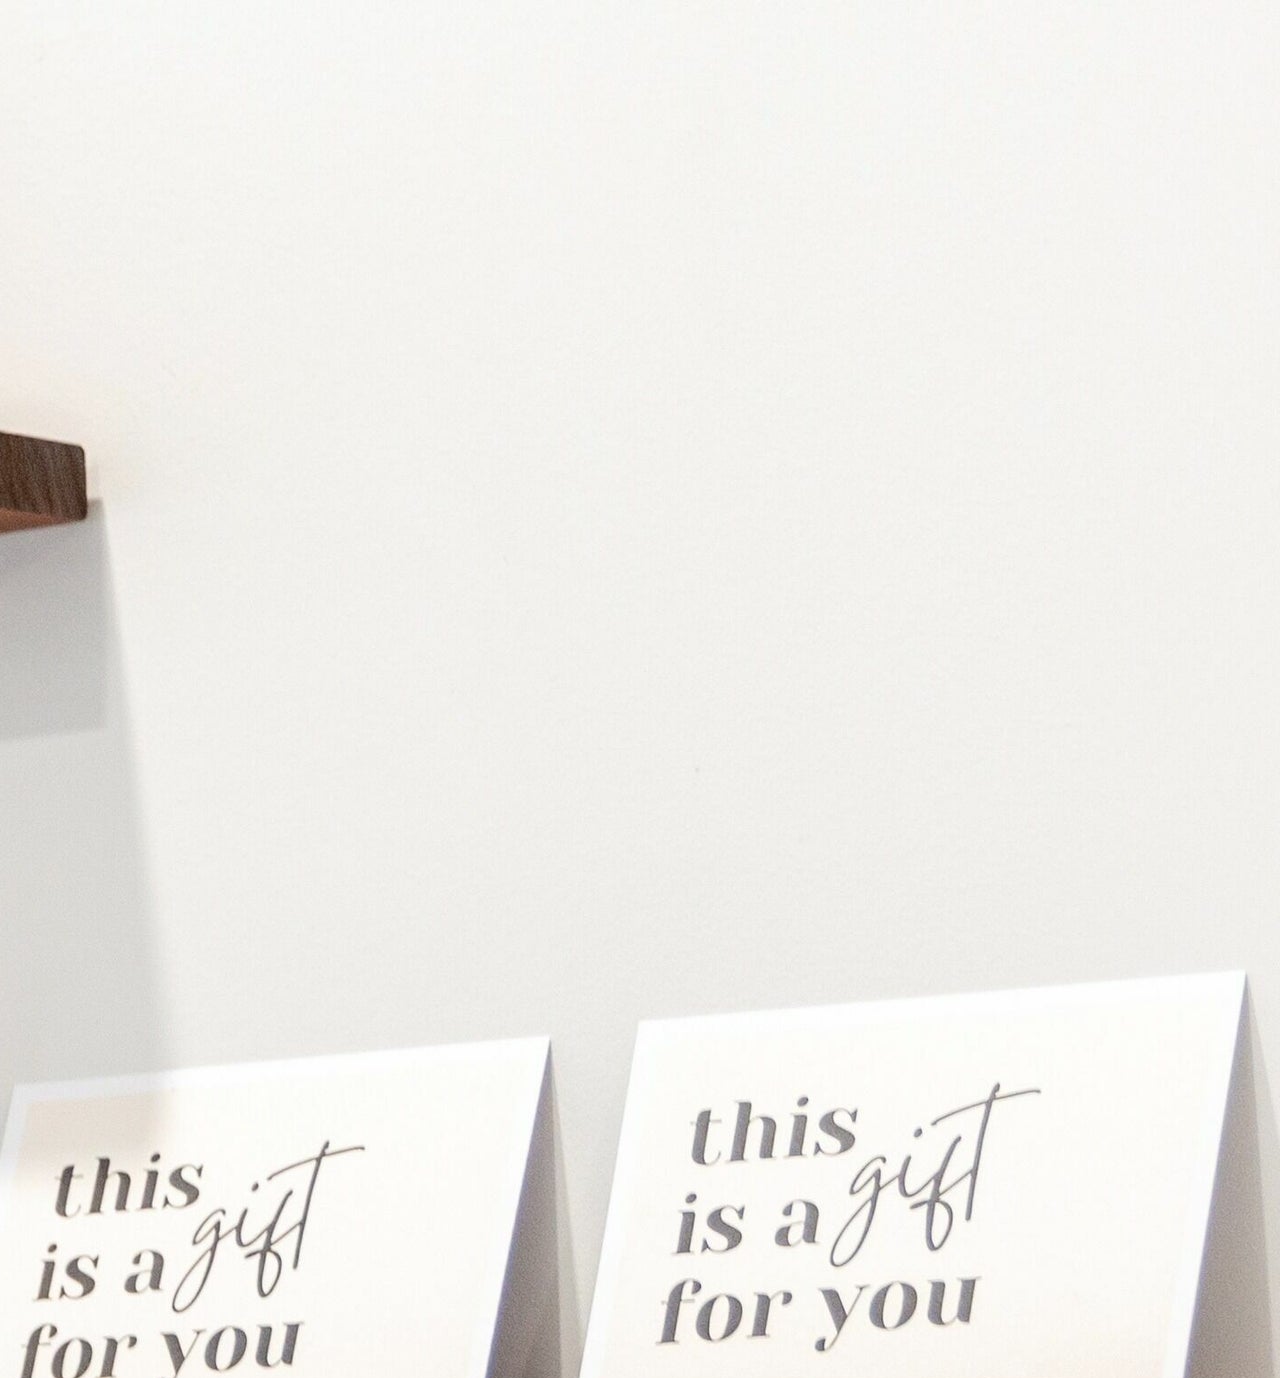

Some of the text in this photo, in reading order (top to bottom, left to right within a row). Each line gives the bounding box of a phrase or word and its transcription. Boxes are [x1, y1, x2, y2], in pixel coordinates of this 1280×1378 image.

[689, 1094, 858, 1167] this
[54, 1152, 204, 1219] this
[670, 1082, 1041, 1268] is a gift
[32, 1139, 366, 1314] is a gift
[655, 1274, 983, 1353] for you
